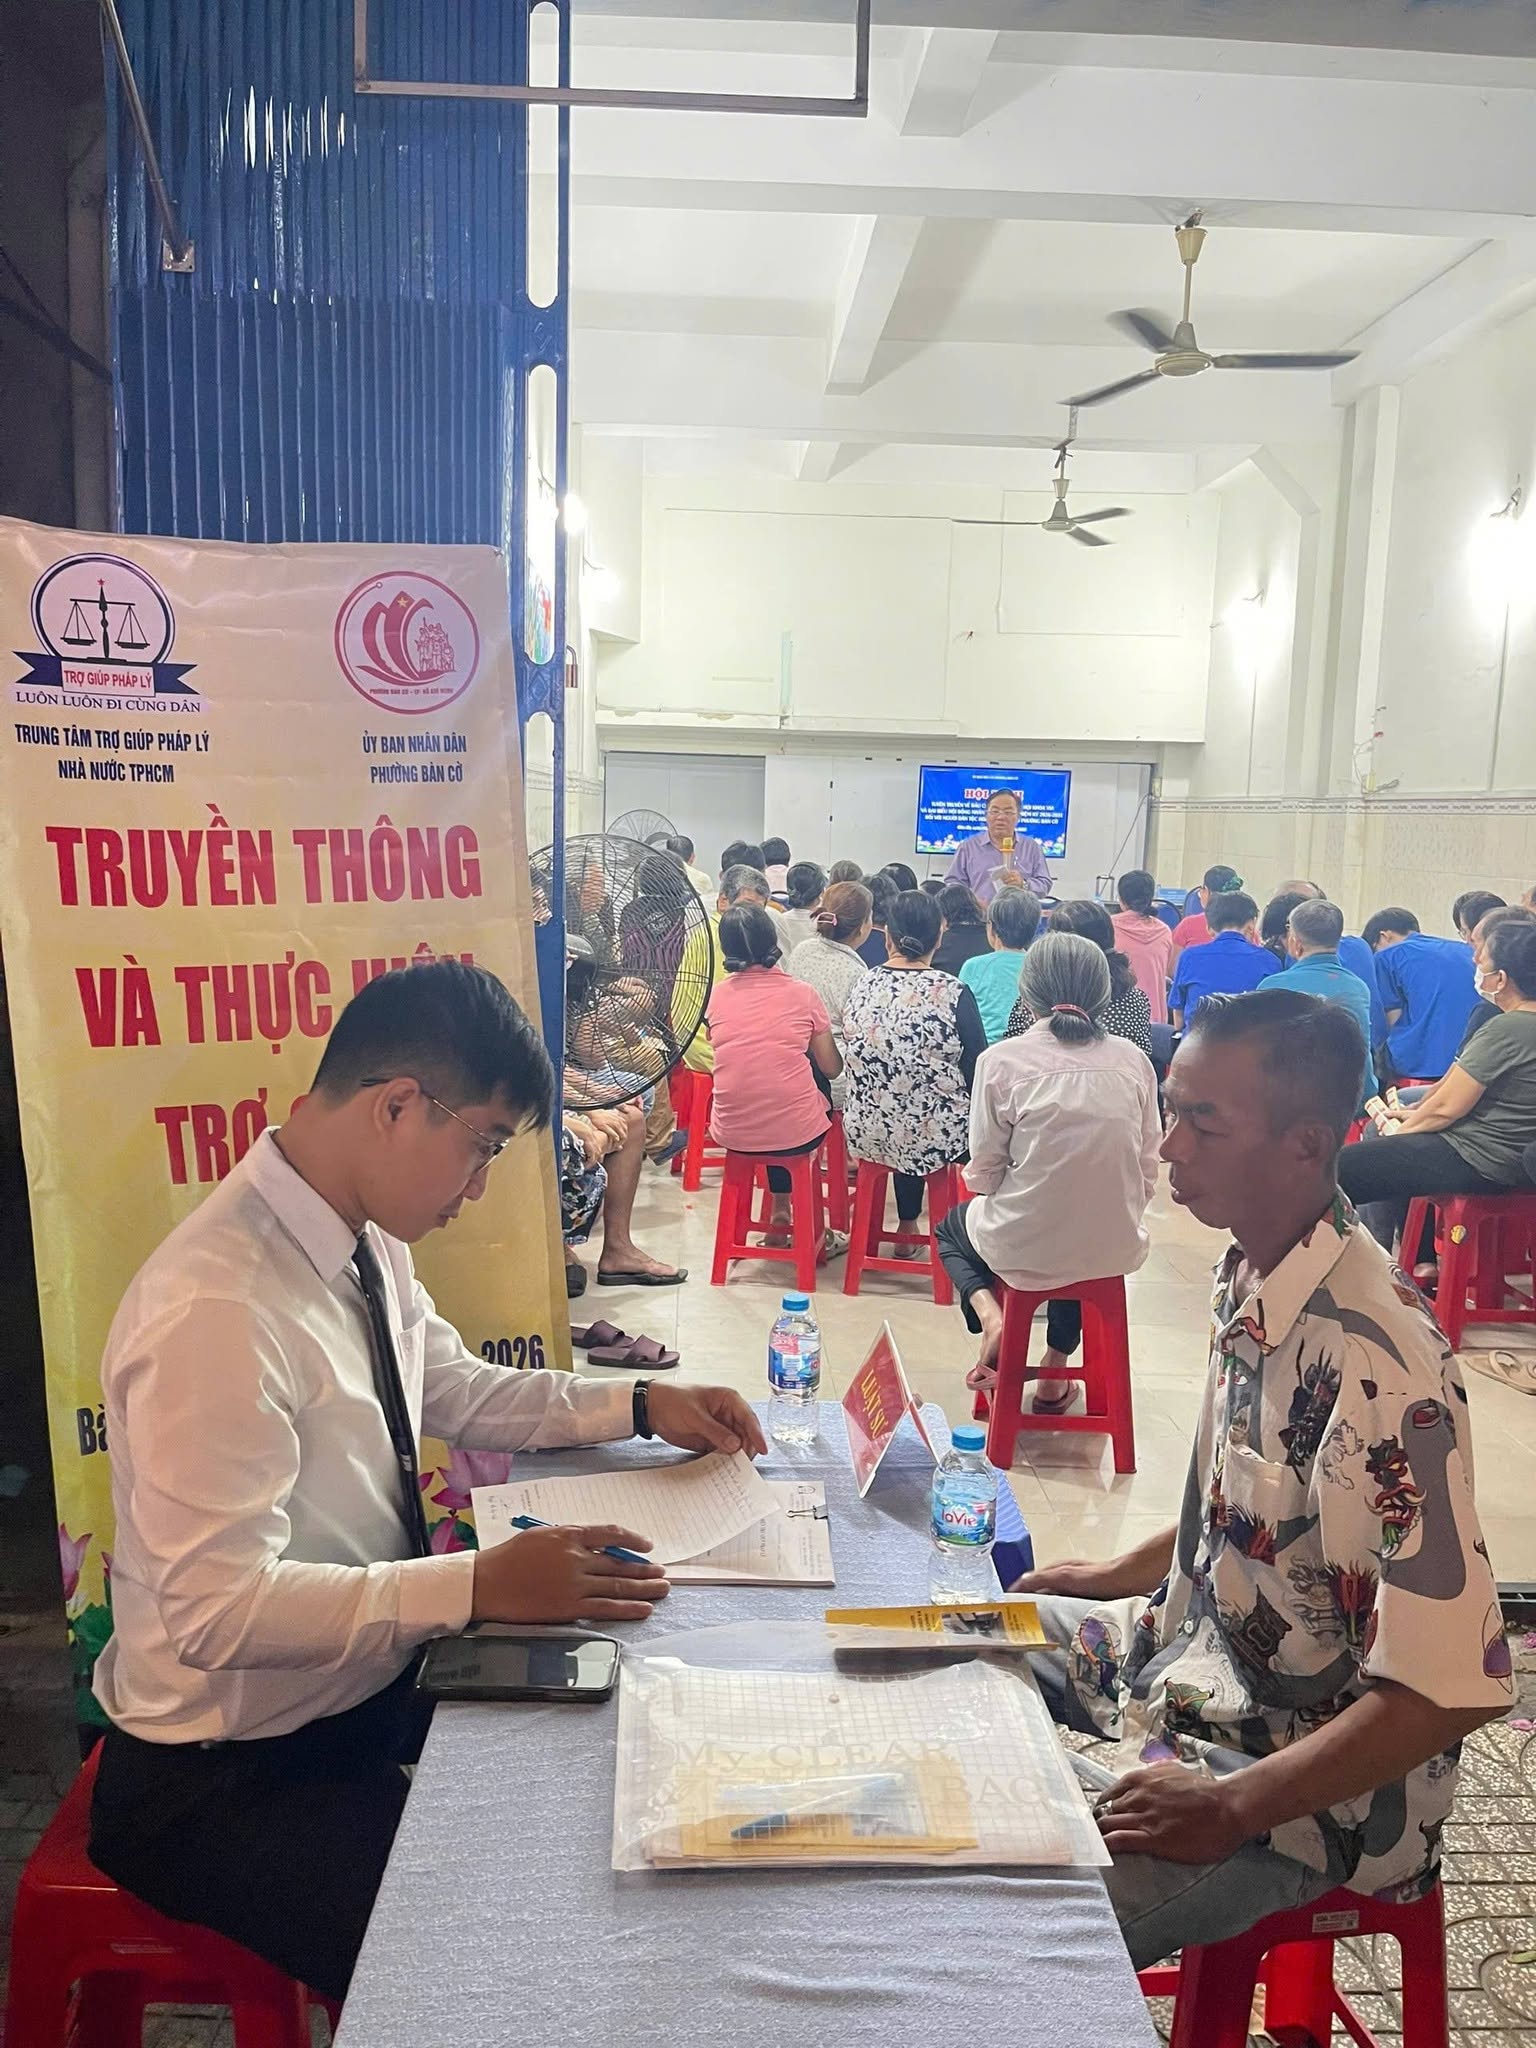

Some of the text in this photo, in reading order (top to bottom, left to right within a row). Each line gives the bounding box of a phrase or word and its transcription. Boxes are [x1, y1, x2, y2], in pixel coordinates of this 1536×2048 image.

[64, 669, 152, 689] TRỢ GIÚP PHÁP LÝ
[16, 691, 201, 713] LUÔN LUÔN ĐI CÙNG DÂN
[15, 724, 210, 753] TRUNG TÂM TRỢ GIÚP PHÁP LÝ
[362, 730, 467, 754] ỦY BAN NHÂN DÂN
[58, 756, 175, 783] NHÀ NƯỚC TPHCM
[370, 761, 463, 783] PHƯỜNG BÀN CỜ
[45, 803, 483, 909] TRUYỀN THÔNG
[75, 954, 162, 1048] VÀ
[174, 951, 334, 1055] THỰC
[770, 1738, 956, 1768] CLEAR
